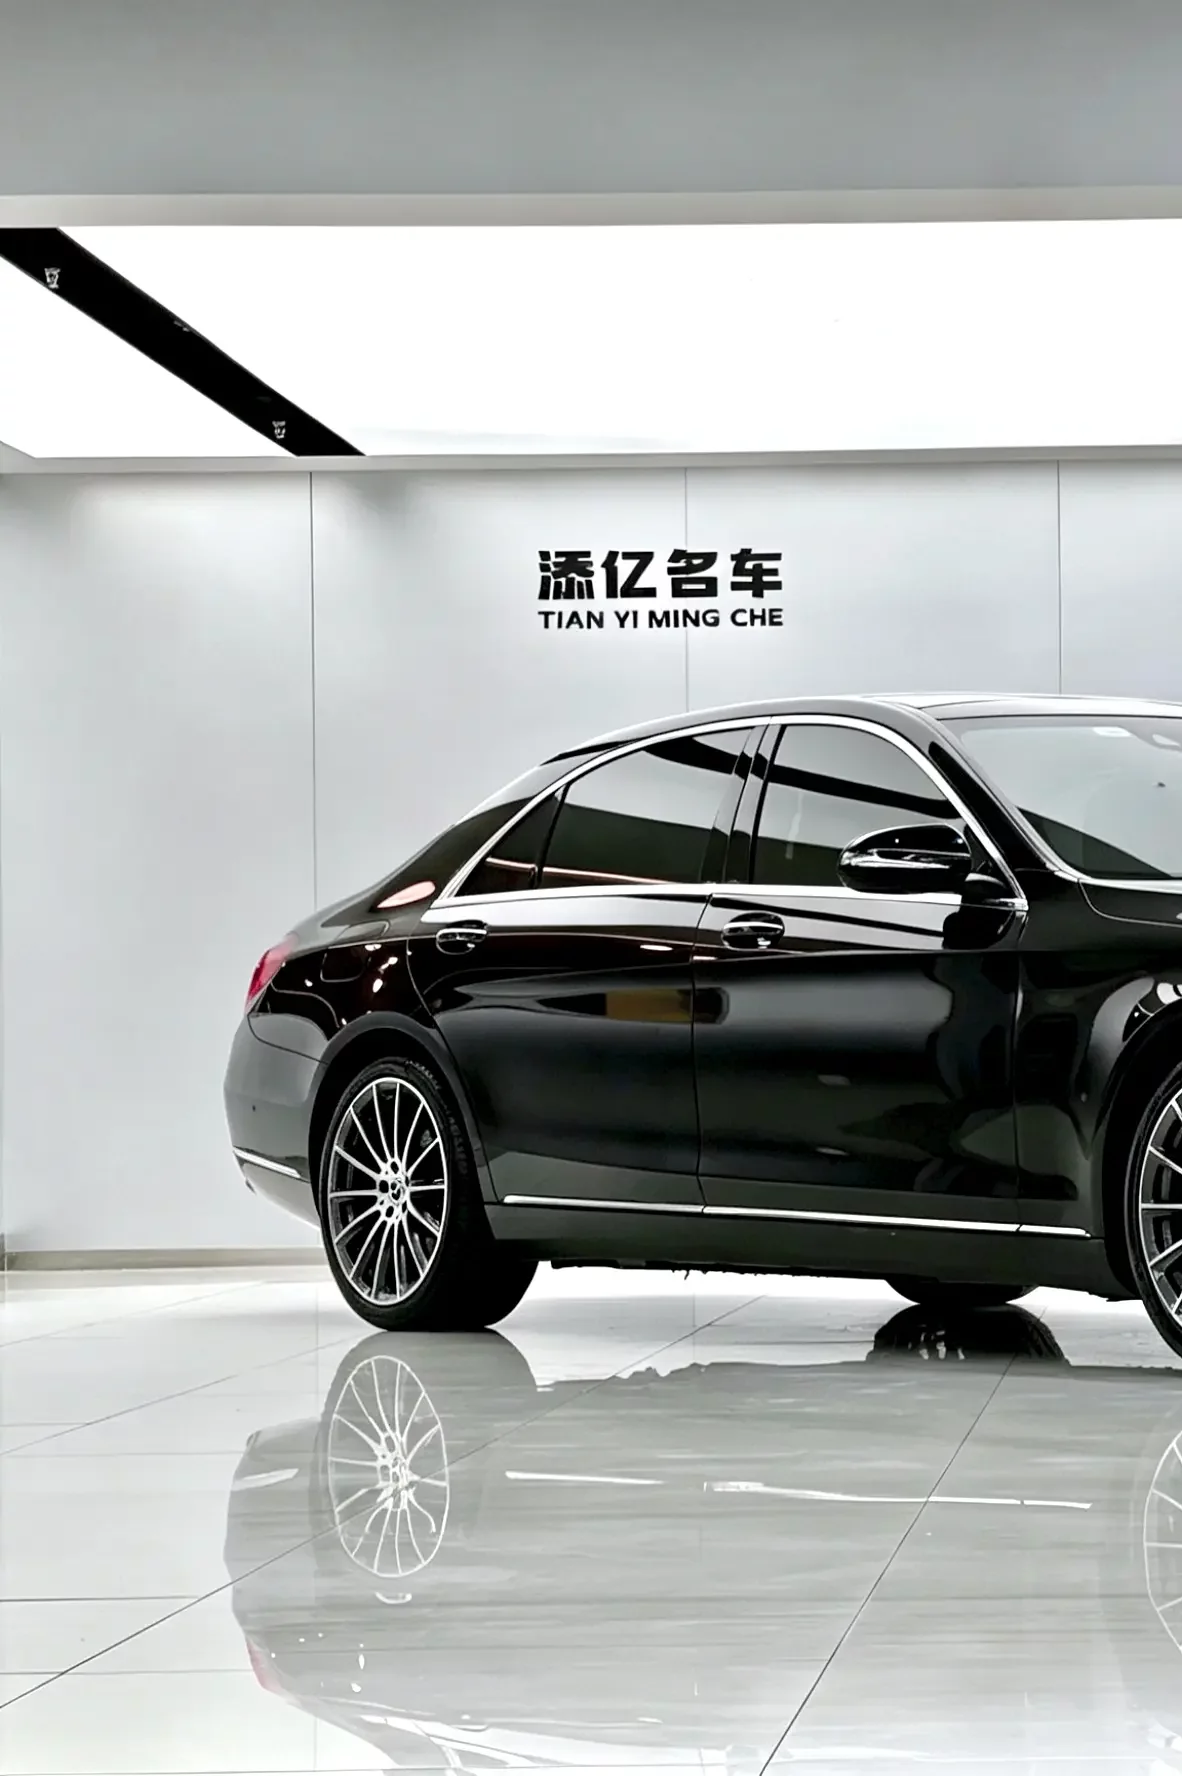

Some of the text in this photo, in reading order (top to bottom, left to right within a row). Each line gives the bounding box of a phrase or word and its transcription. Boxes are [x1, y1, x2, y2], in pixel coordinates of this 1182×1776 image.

[538, 549, 783, 600] 添亿名车
[538, 608, 784, 629] TIAN YI MING CHE
